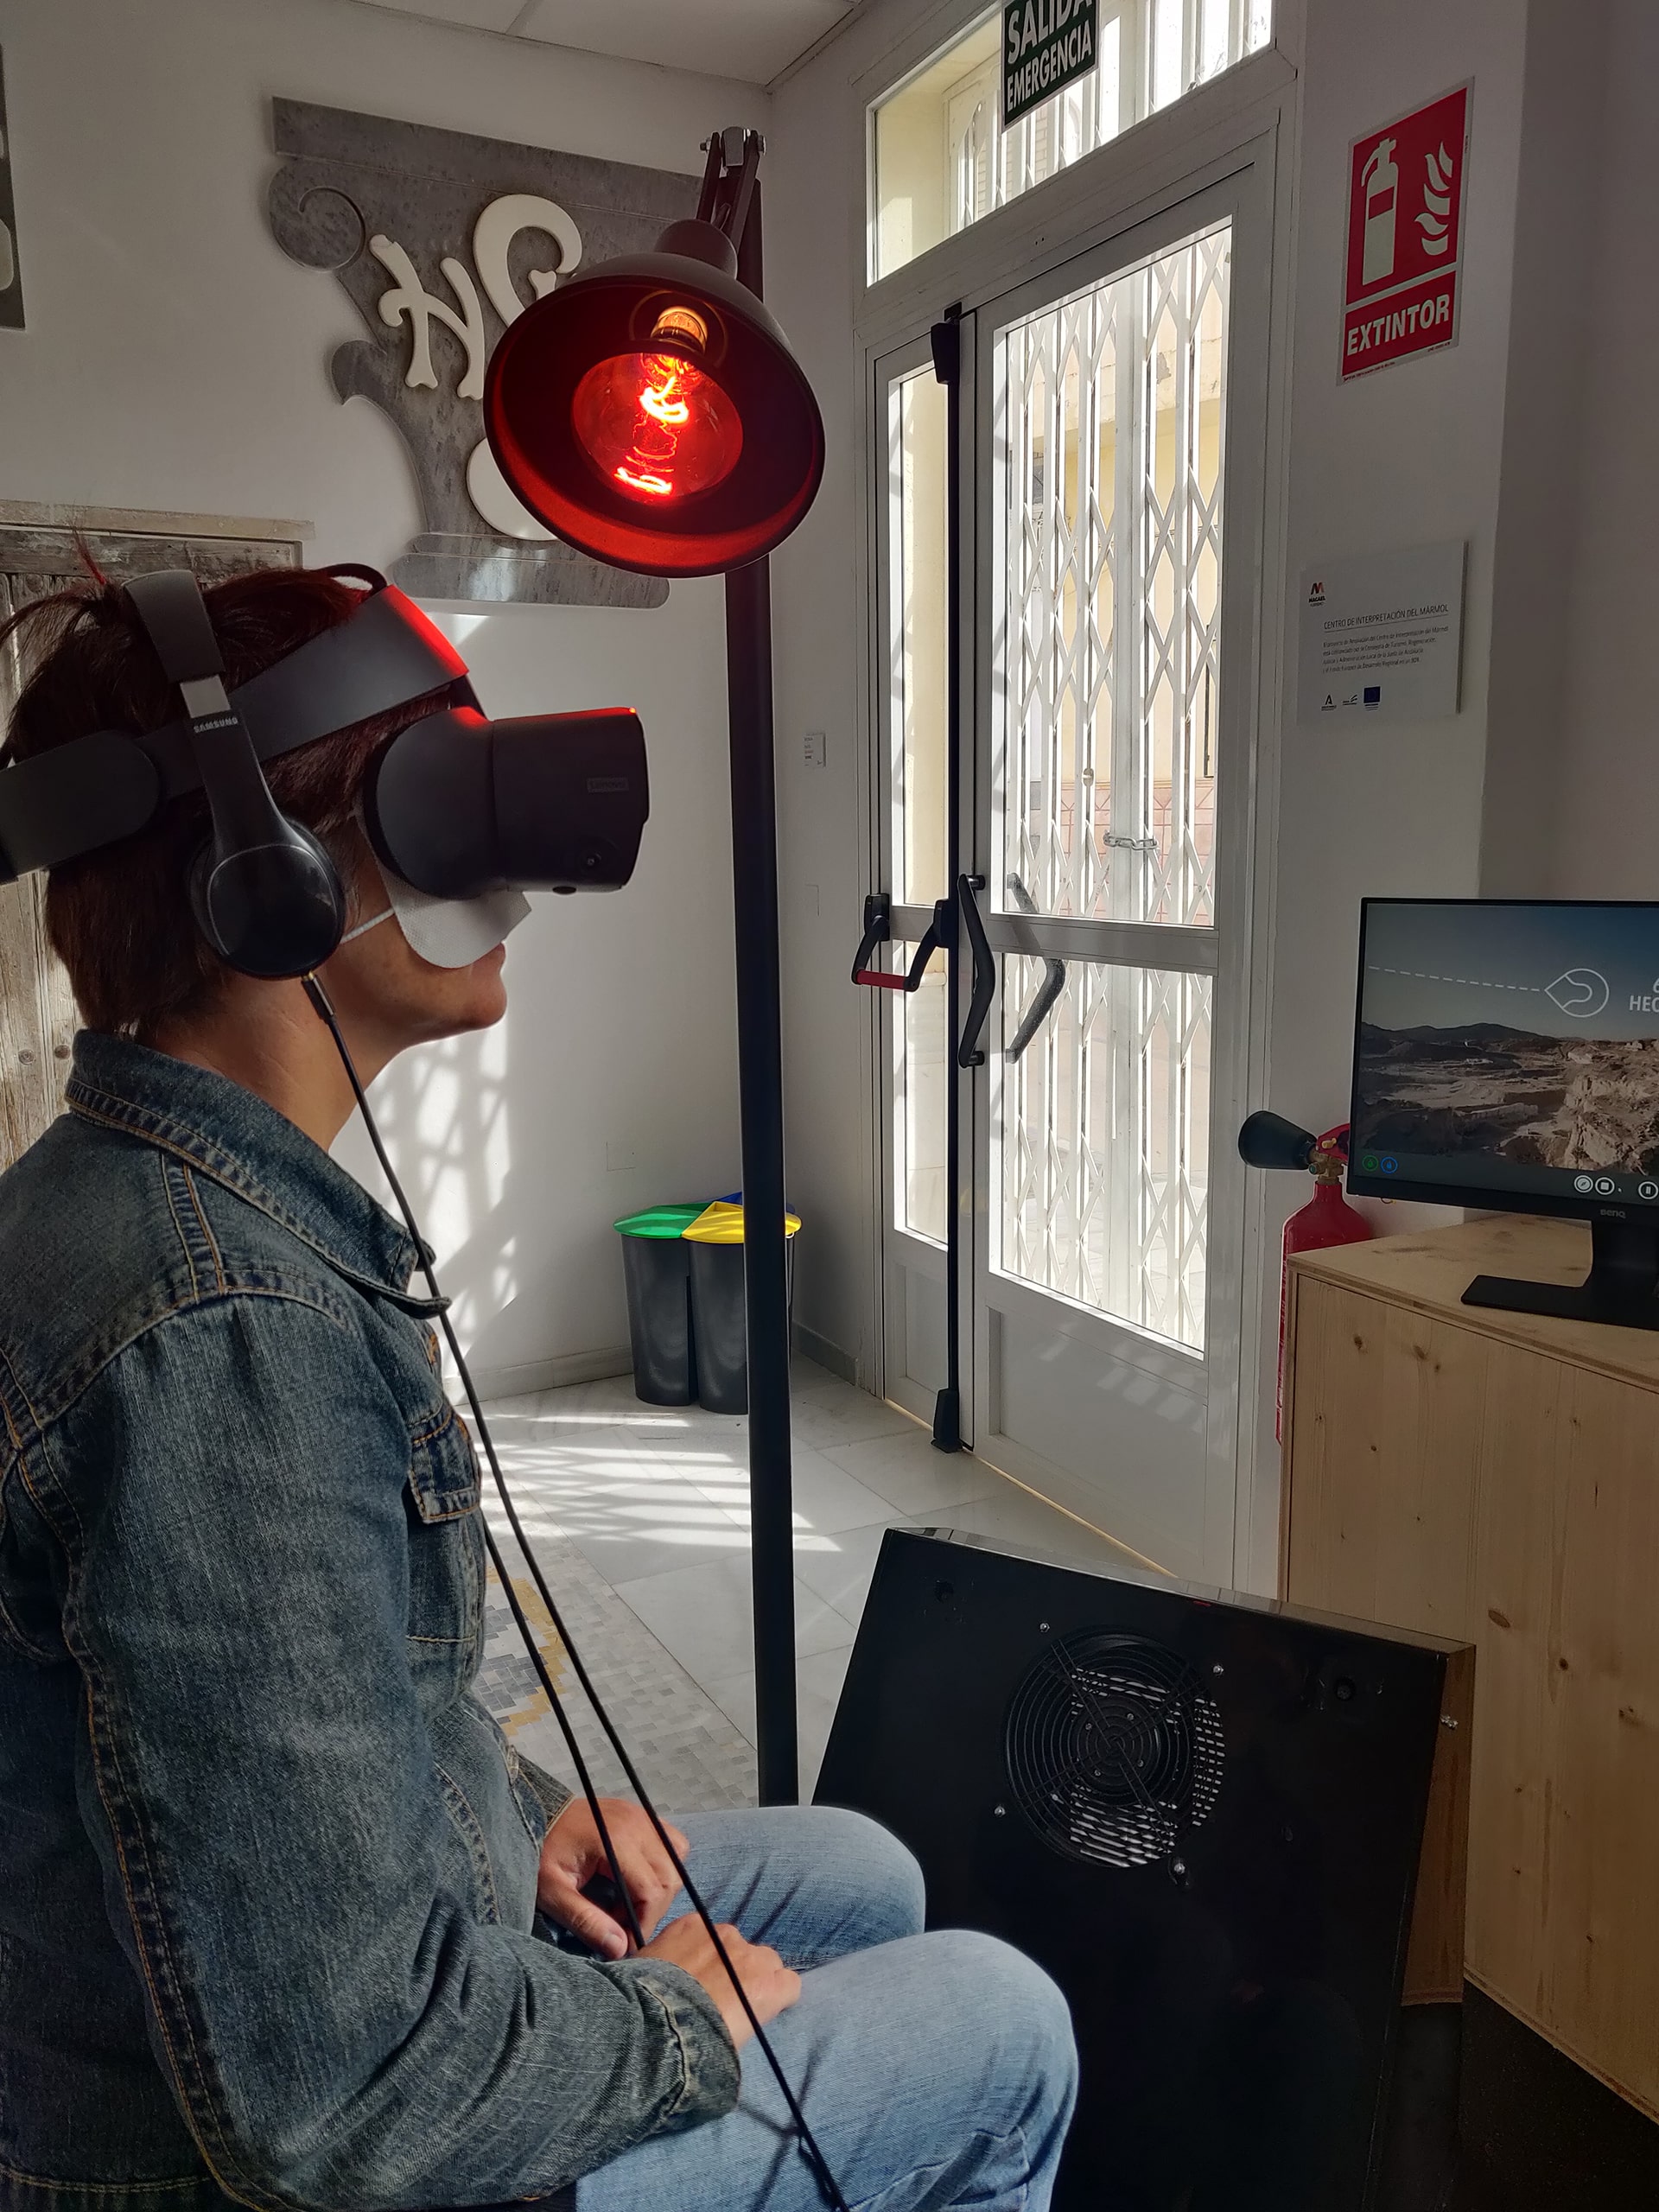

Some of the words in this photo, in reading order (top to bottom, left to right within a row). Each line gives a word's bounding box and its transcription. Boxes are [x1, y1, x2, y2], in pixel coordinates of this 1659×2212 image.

[1007, 0, 1092, 65] SALID
[1007, 19, 1092, 113] EMERGENCIA
[1346, 293, 1451, 356] EXTINTOR
[1323, 619, 1346, 630] CENTRO
[1346, 617, 1355, 626] DE
[1407, 607, 1419, 618] DEL
[193, 716, 238, 734] SAMSUNG
